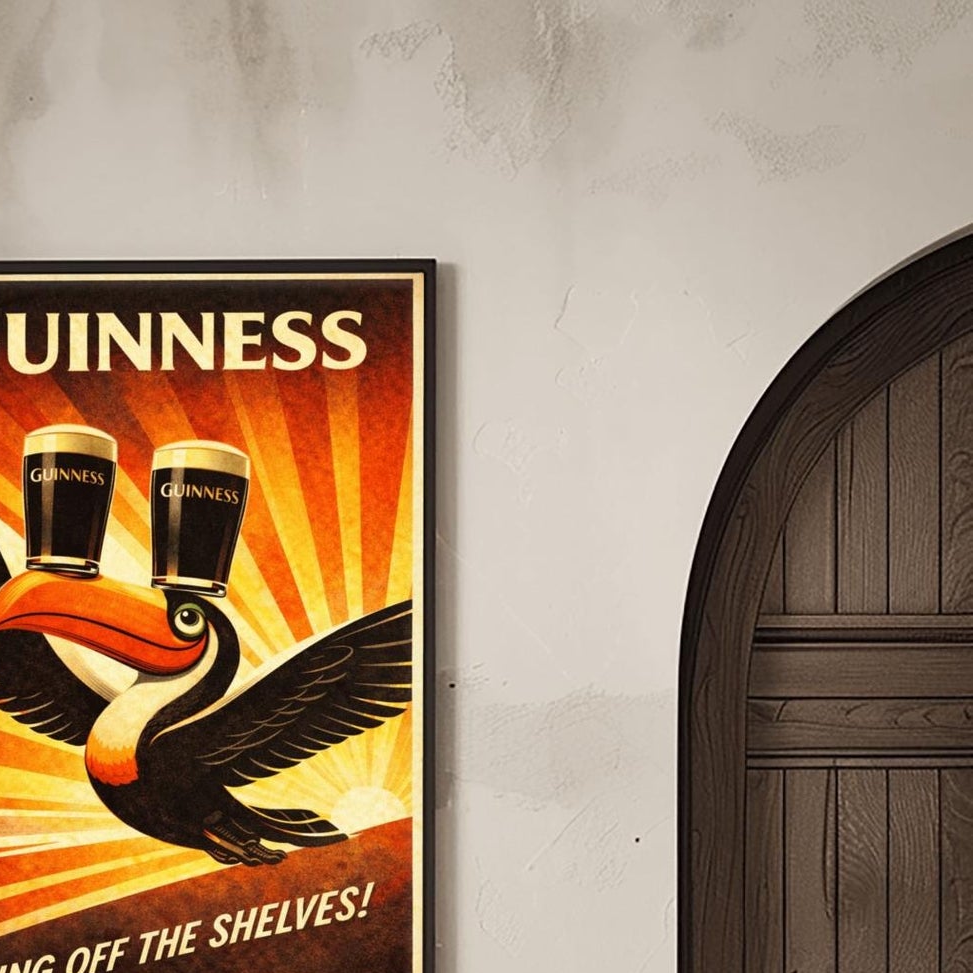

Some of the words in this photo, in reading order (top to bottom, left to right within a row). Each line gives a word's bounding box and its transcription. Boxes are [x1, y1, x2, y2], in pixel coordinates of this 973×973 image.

[30, 466, 105, 486] GUINNESS
[160, 481, 240, 505] GUINNESS
[137, 919, 203, 965] THE
[208, 881, 376, 948] SHELVES!
